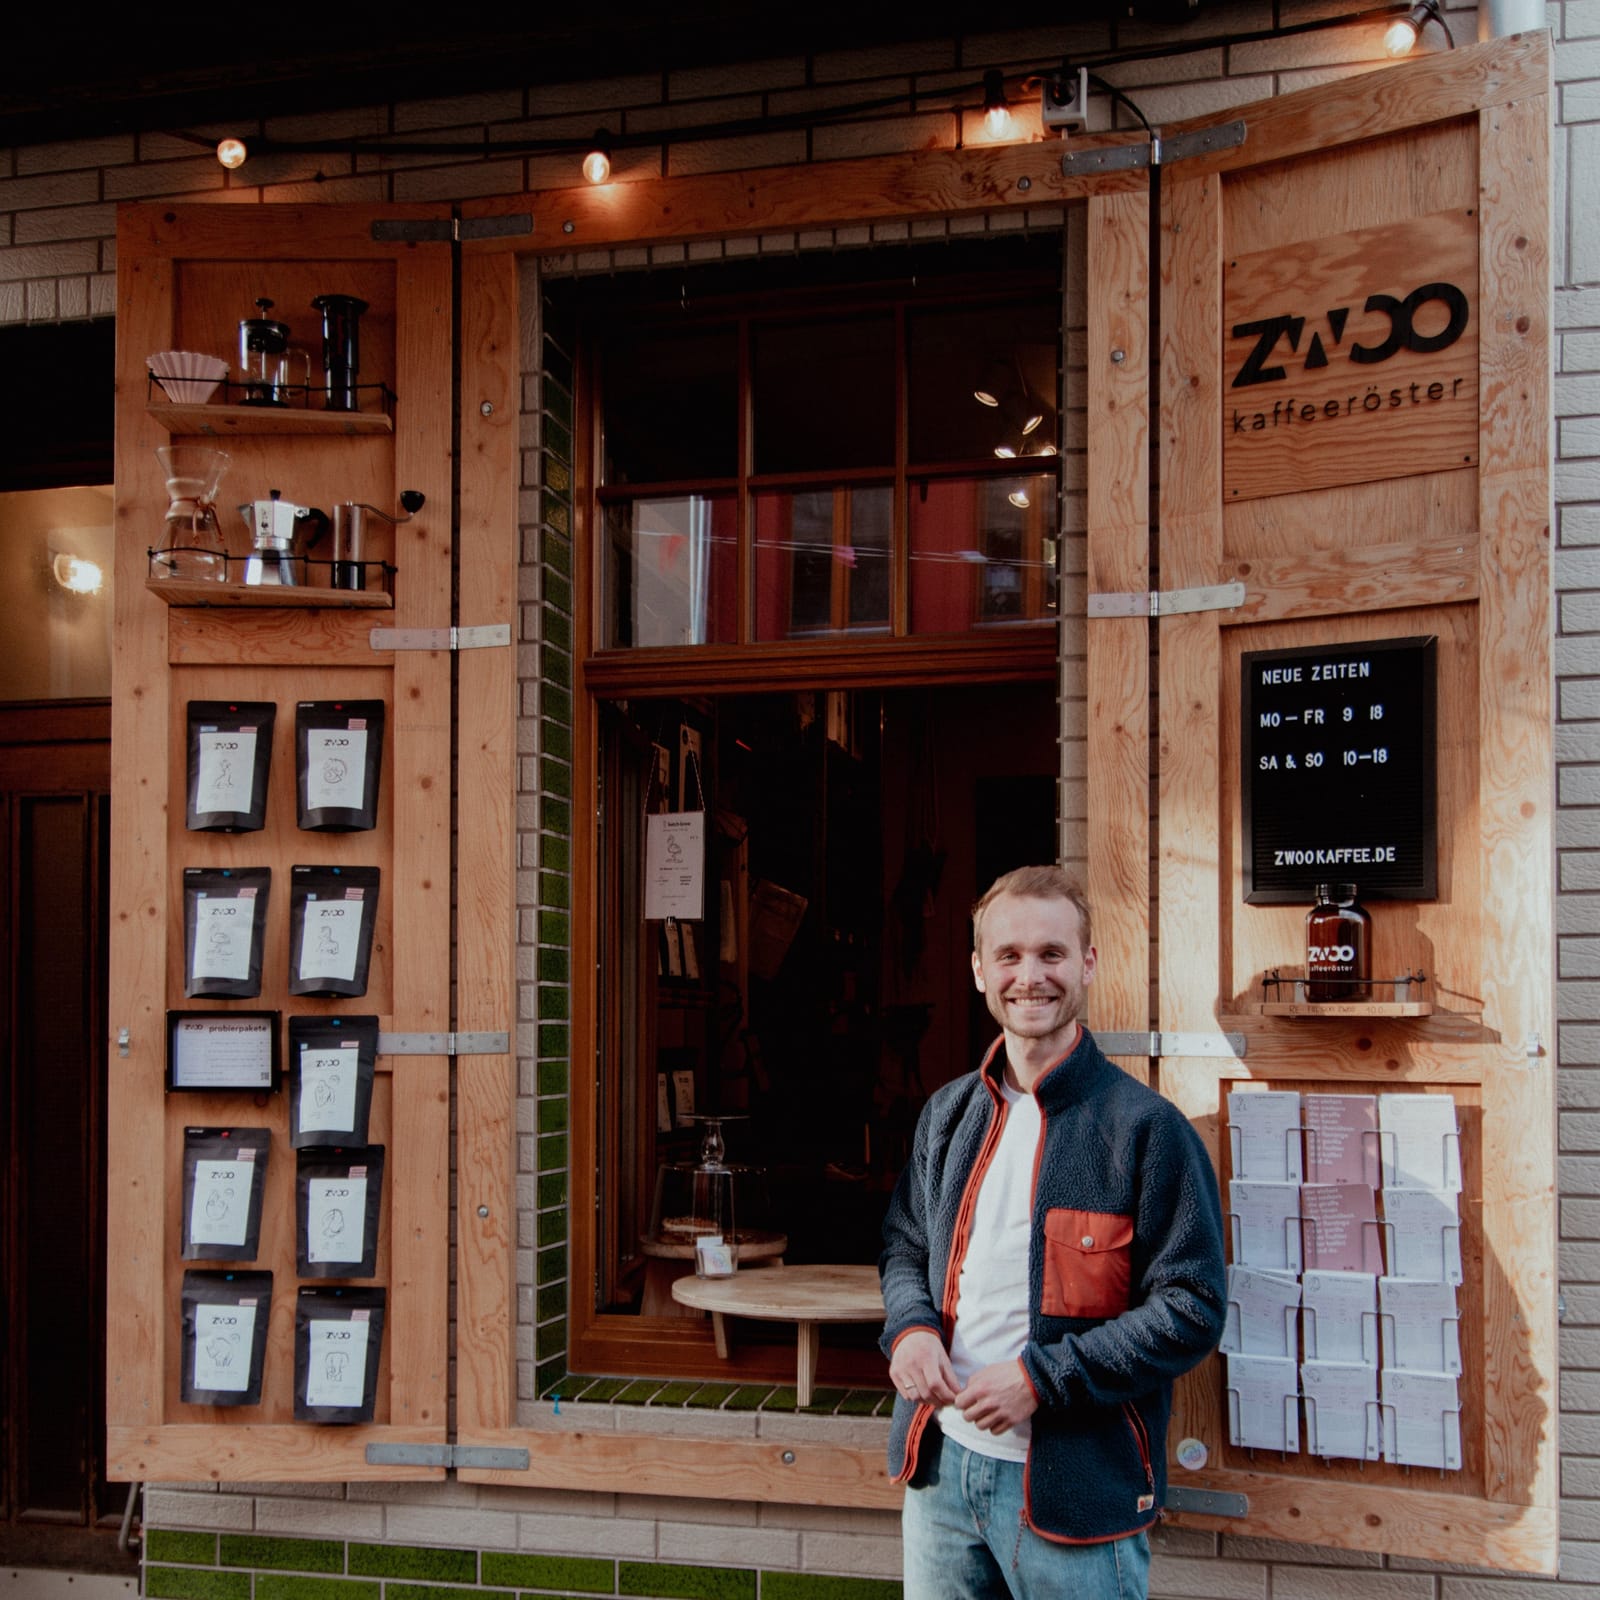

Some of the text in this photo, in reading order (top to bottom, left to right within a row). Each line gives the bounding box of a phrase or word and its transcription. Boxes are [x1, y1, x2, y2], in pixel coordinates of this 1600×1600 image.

[1233, 378, 1463, 433] kaffeeröster
[1262, 662, 1370, 685] NEUE ZEITEN
[1260, 712, 1280, 728] MO
[1304, 709, 1324, 724] FR
[1342, 707, 1353, 722] 9
[1370, 704, 1383, 720] 18
[1259, 755, 1278, 770] SA
[1285, 754, 1297, 769] &
[1305, 752, 1324, 768] SO
[1274, 847, 1396, 866] ZWOOKAFFEE.DE
[208, 1024, 267, 1035] probierpakete
